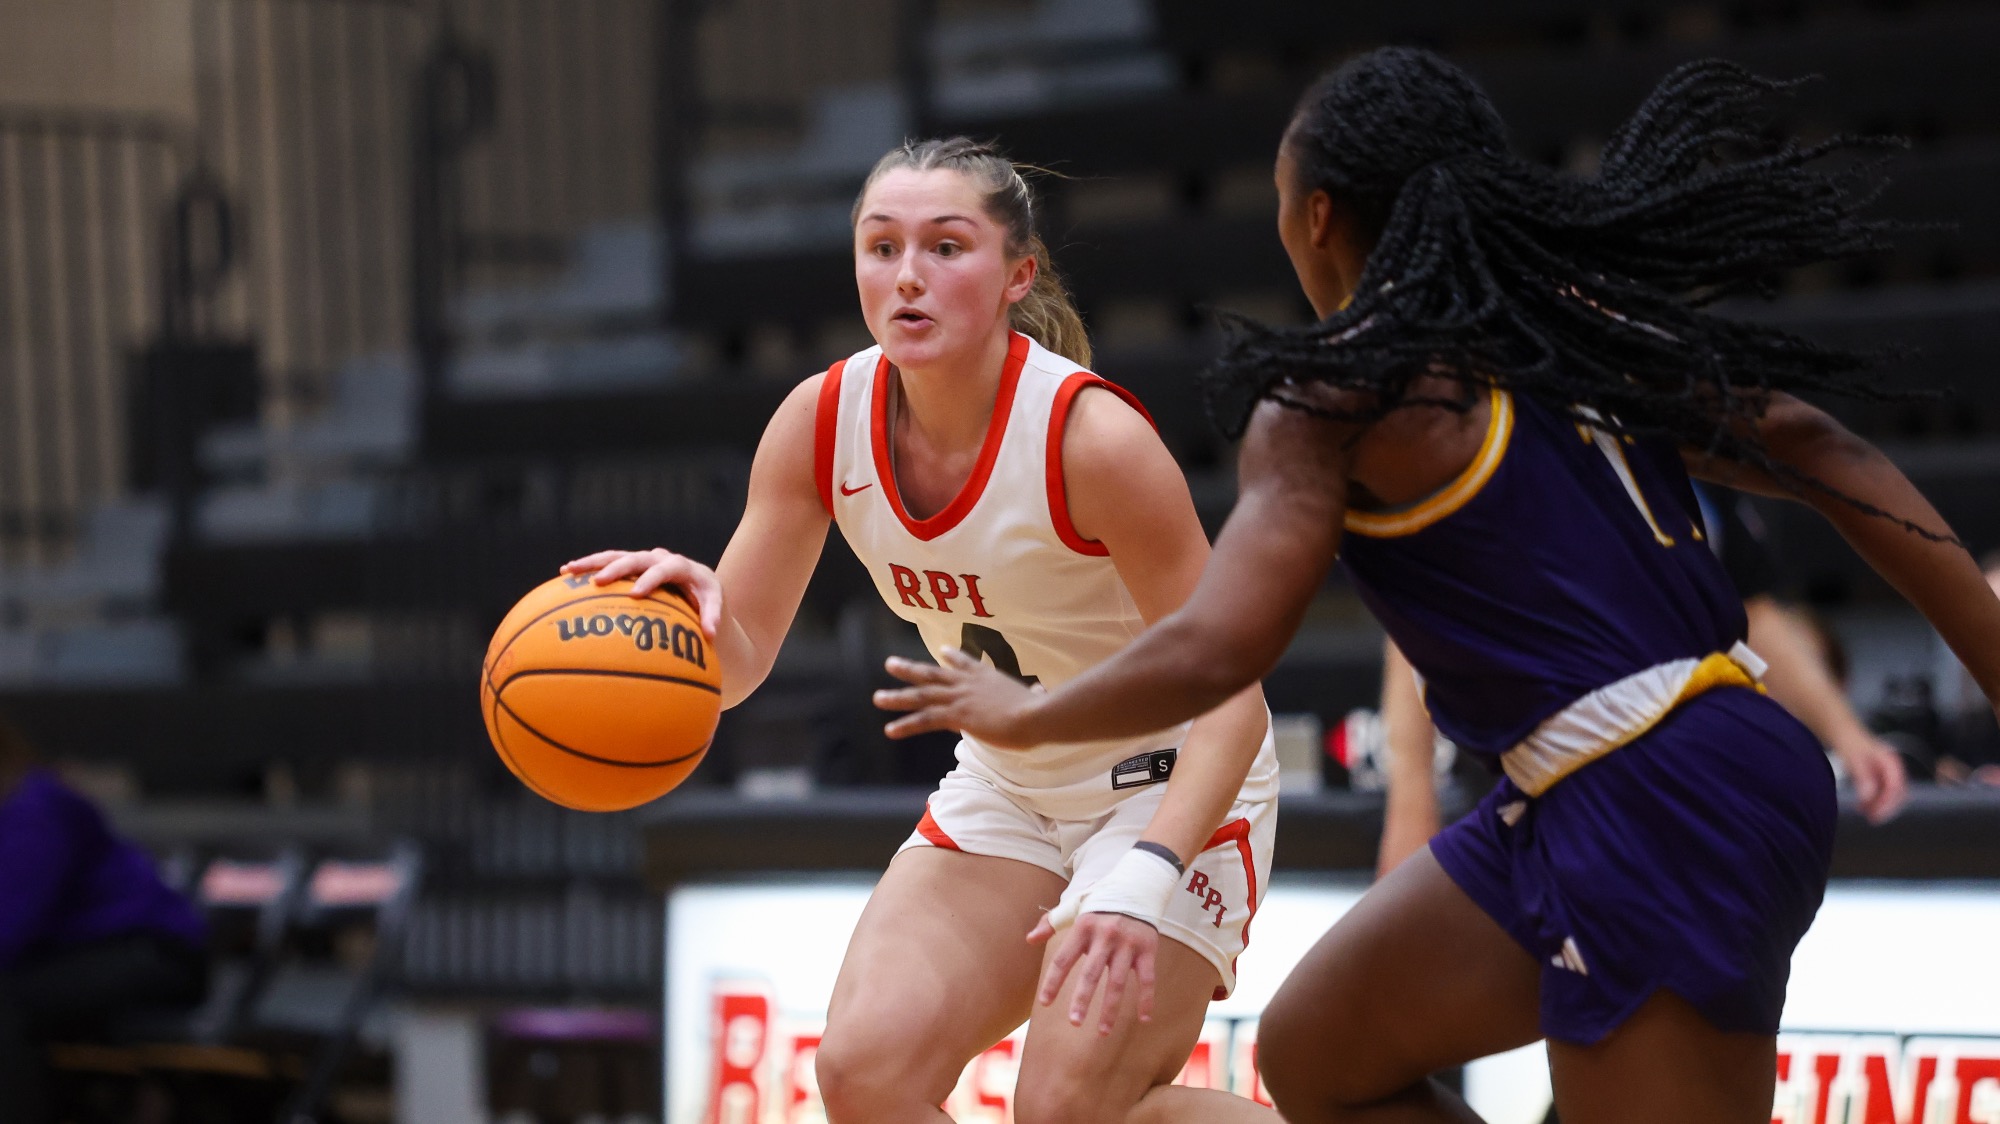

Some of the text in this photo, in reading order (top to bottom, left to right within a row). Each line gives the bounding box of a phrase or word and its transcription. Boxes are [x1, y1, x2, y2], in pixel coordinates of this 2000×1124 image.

[888, 562, 995, 618] RPI
[556, 613, 707, 671] Wilson
[1158, 759, 1169, 773] S
[1185, 869, 1227, 929] RPI
